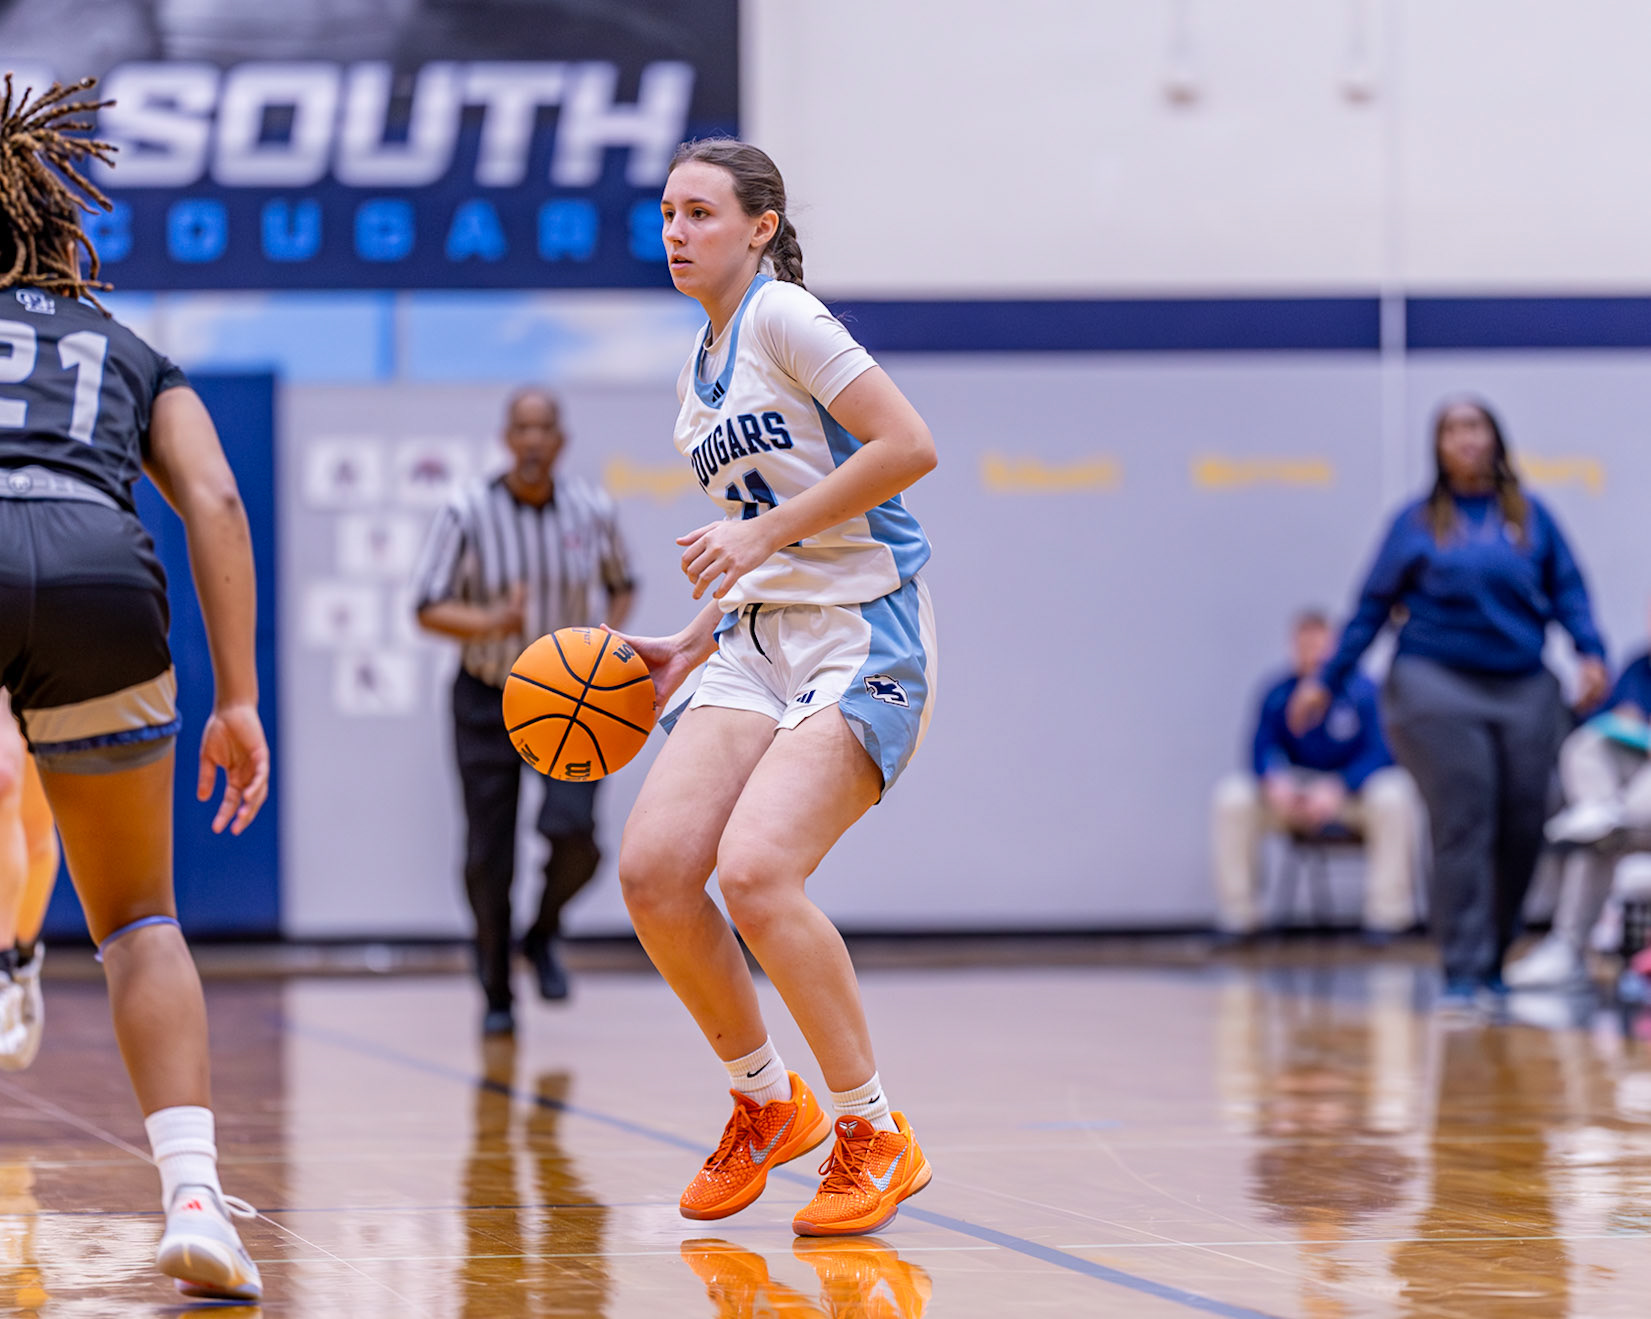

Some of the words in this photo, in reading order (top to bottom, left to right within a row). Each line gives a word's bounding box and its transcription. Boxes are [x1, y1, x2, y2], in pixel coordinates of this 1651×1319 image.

[93, 60, 697, 188] SOUTH
[0, 318, 108, 446] 21
[691, 411, 794, 489] OUGARS
